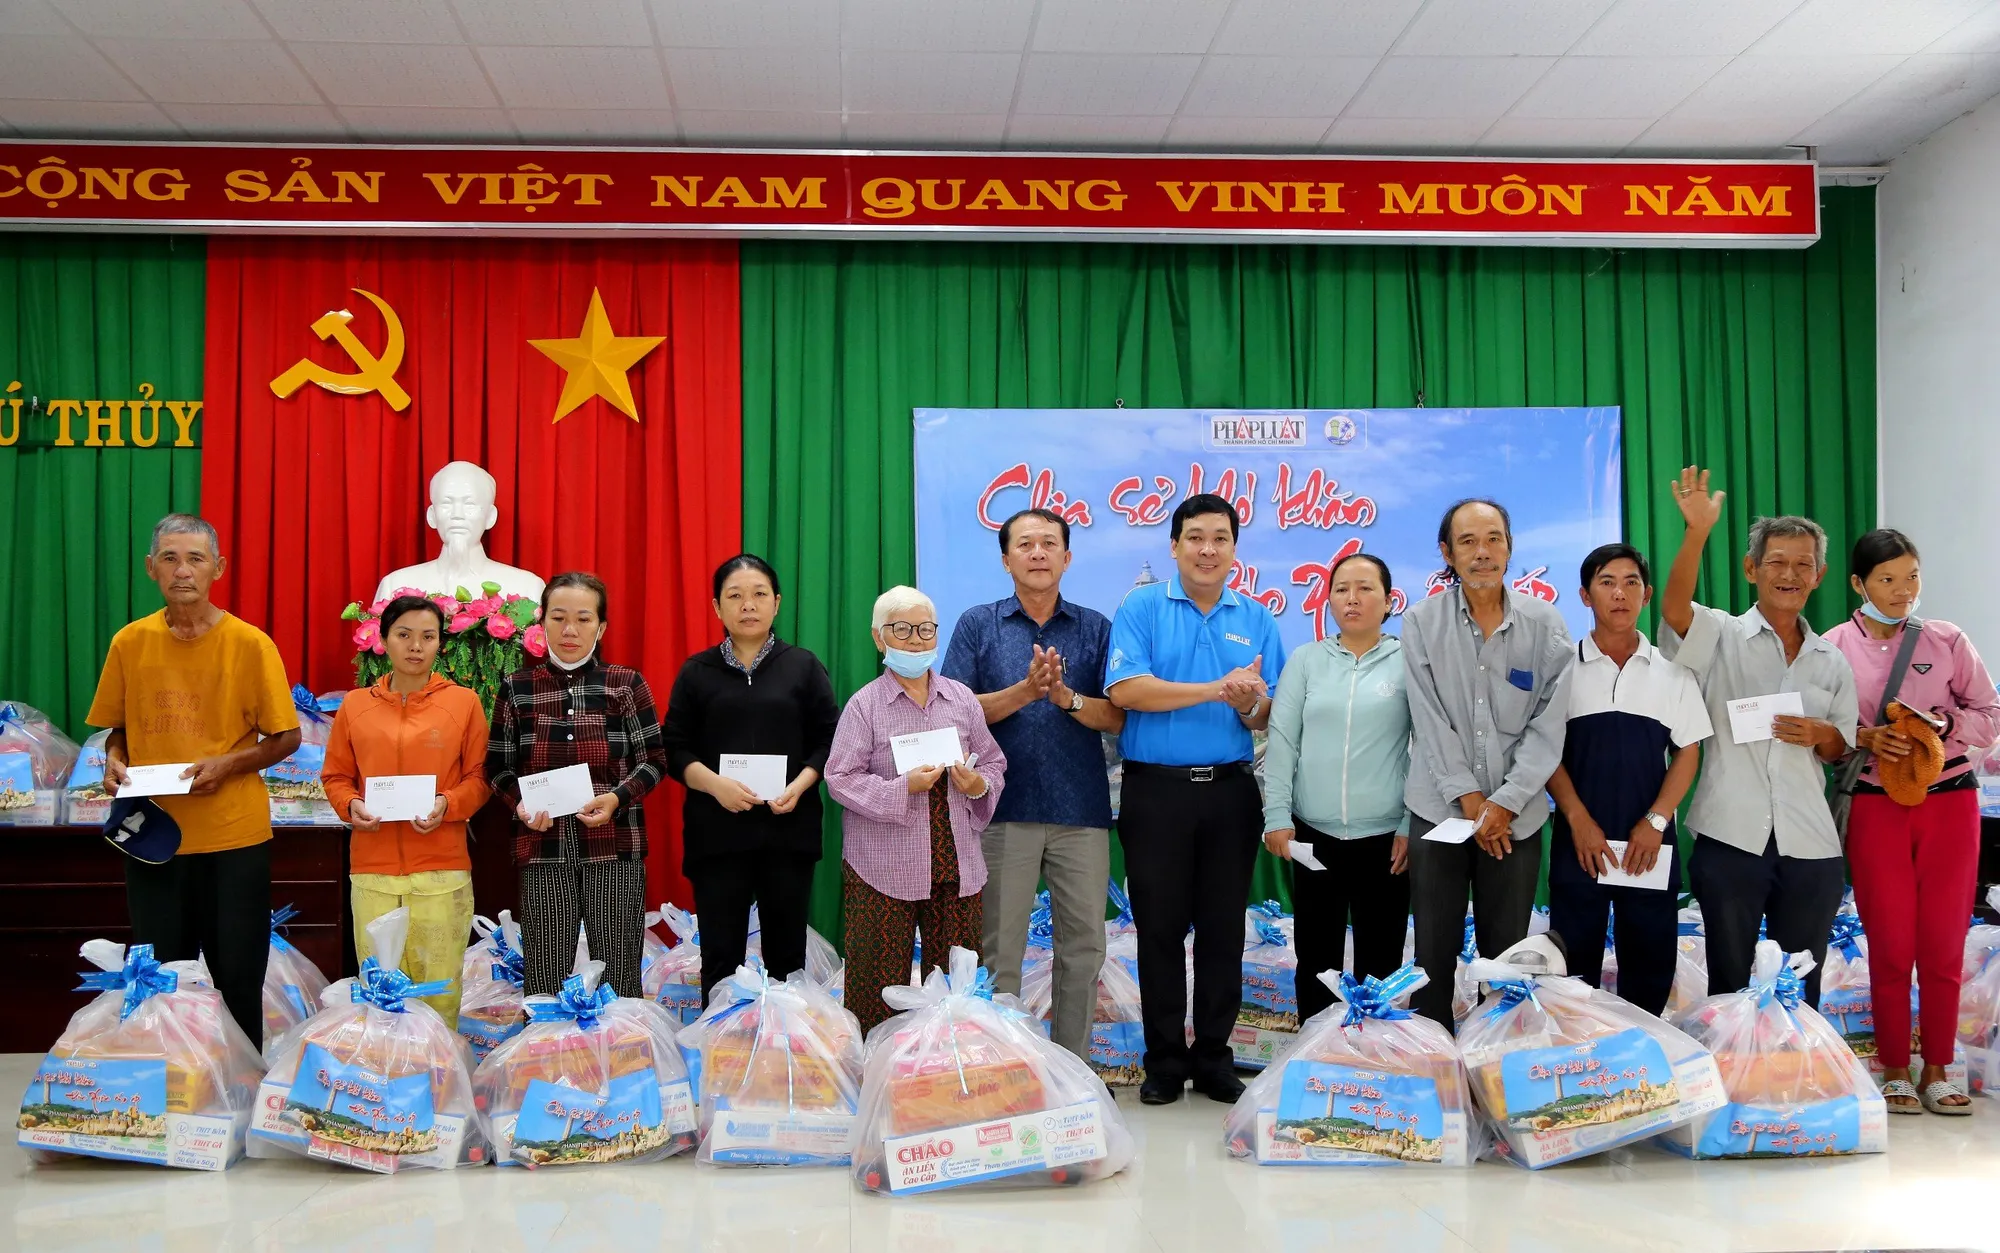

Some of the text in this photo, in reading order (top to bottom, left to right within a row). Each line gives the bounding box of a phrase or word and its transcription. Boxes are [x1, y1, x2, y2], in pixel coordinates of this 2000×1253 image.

[226, 158, 384, 203] SẢN
[424, 163, 613, 213] VIỆT
[652, 176, 827, 208] NAM
[862, 178, 1127, 218] QUANG
[1158, 182, 1345, 212] VINH
[1380, 174, 1587, 215] MUÔN
[1624, 176, 1792, 216] NĂM
[46, 382, 203, 447] THỦY
[897, 1137, 955, 1164] CHÁO
